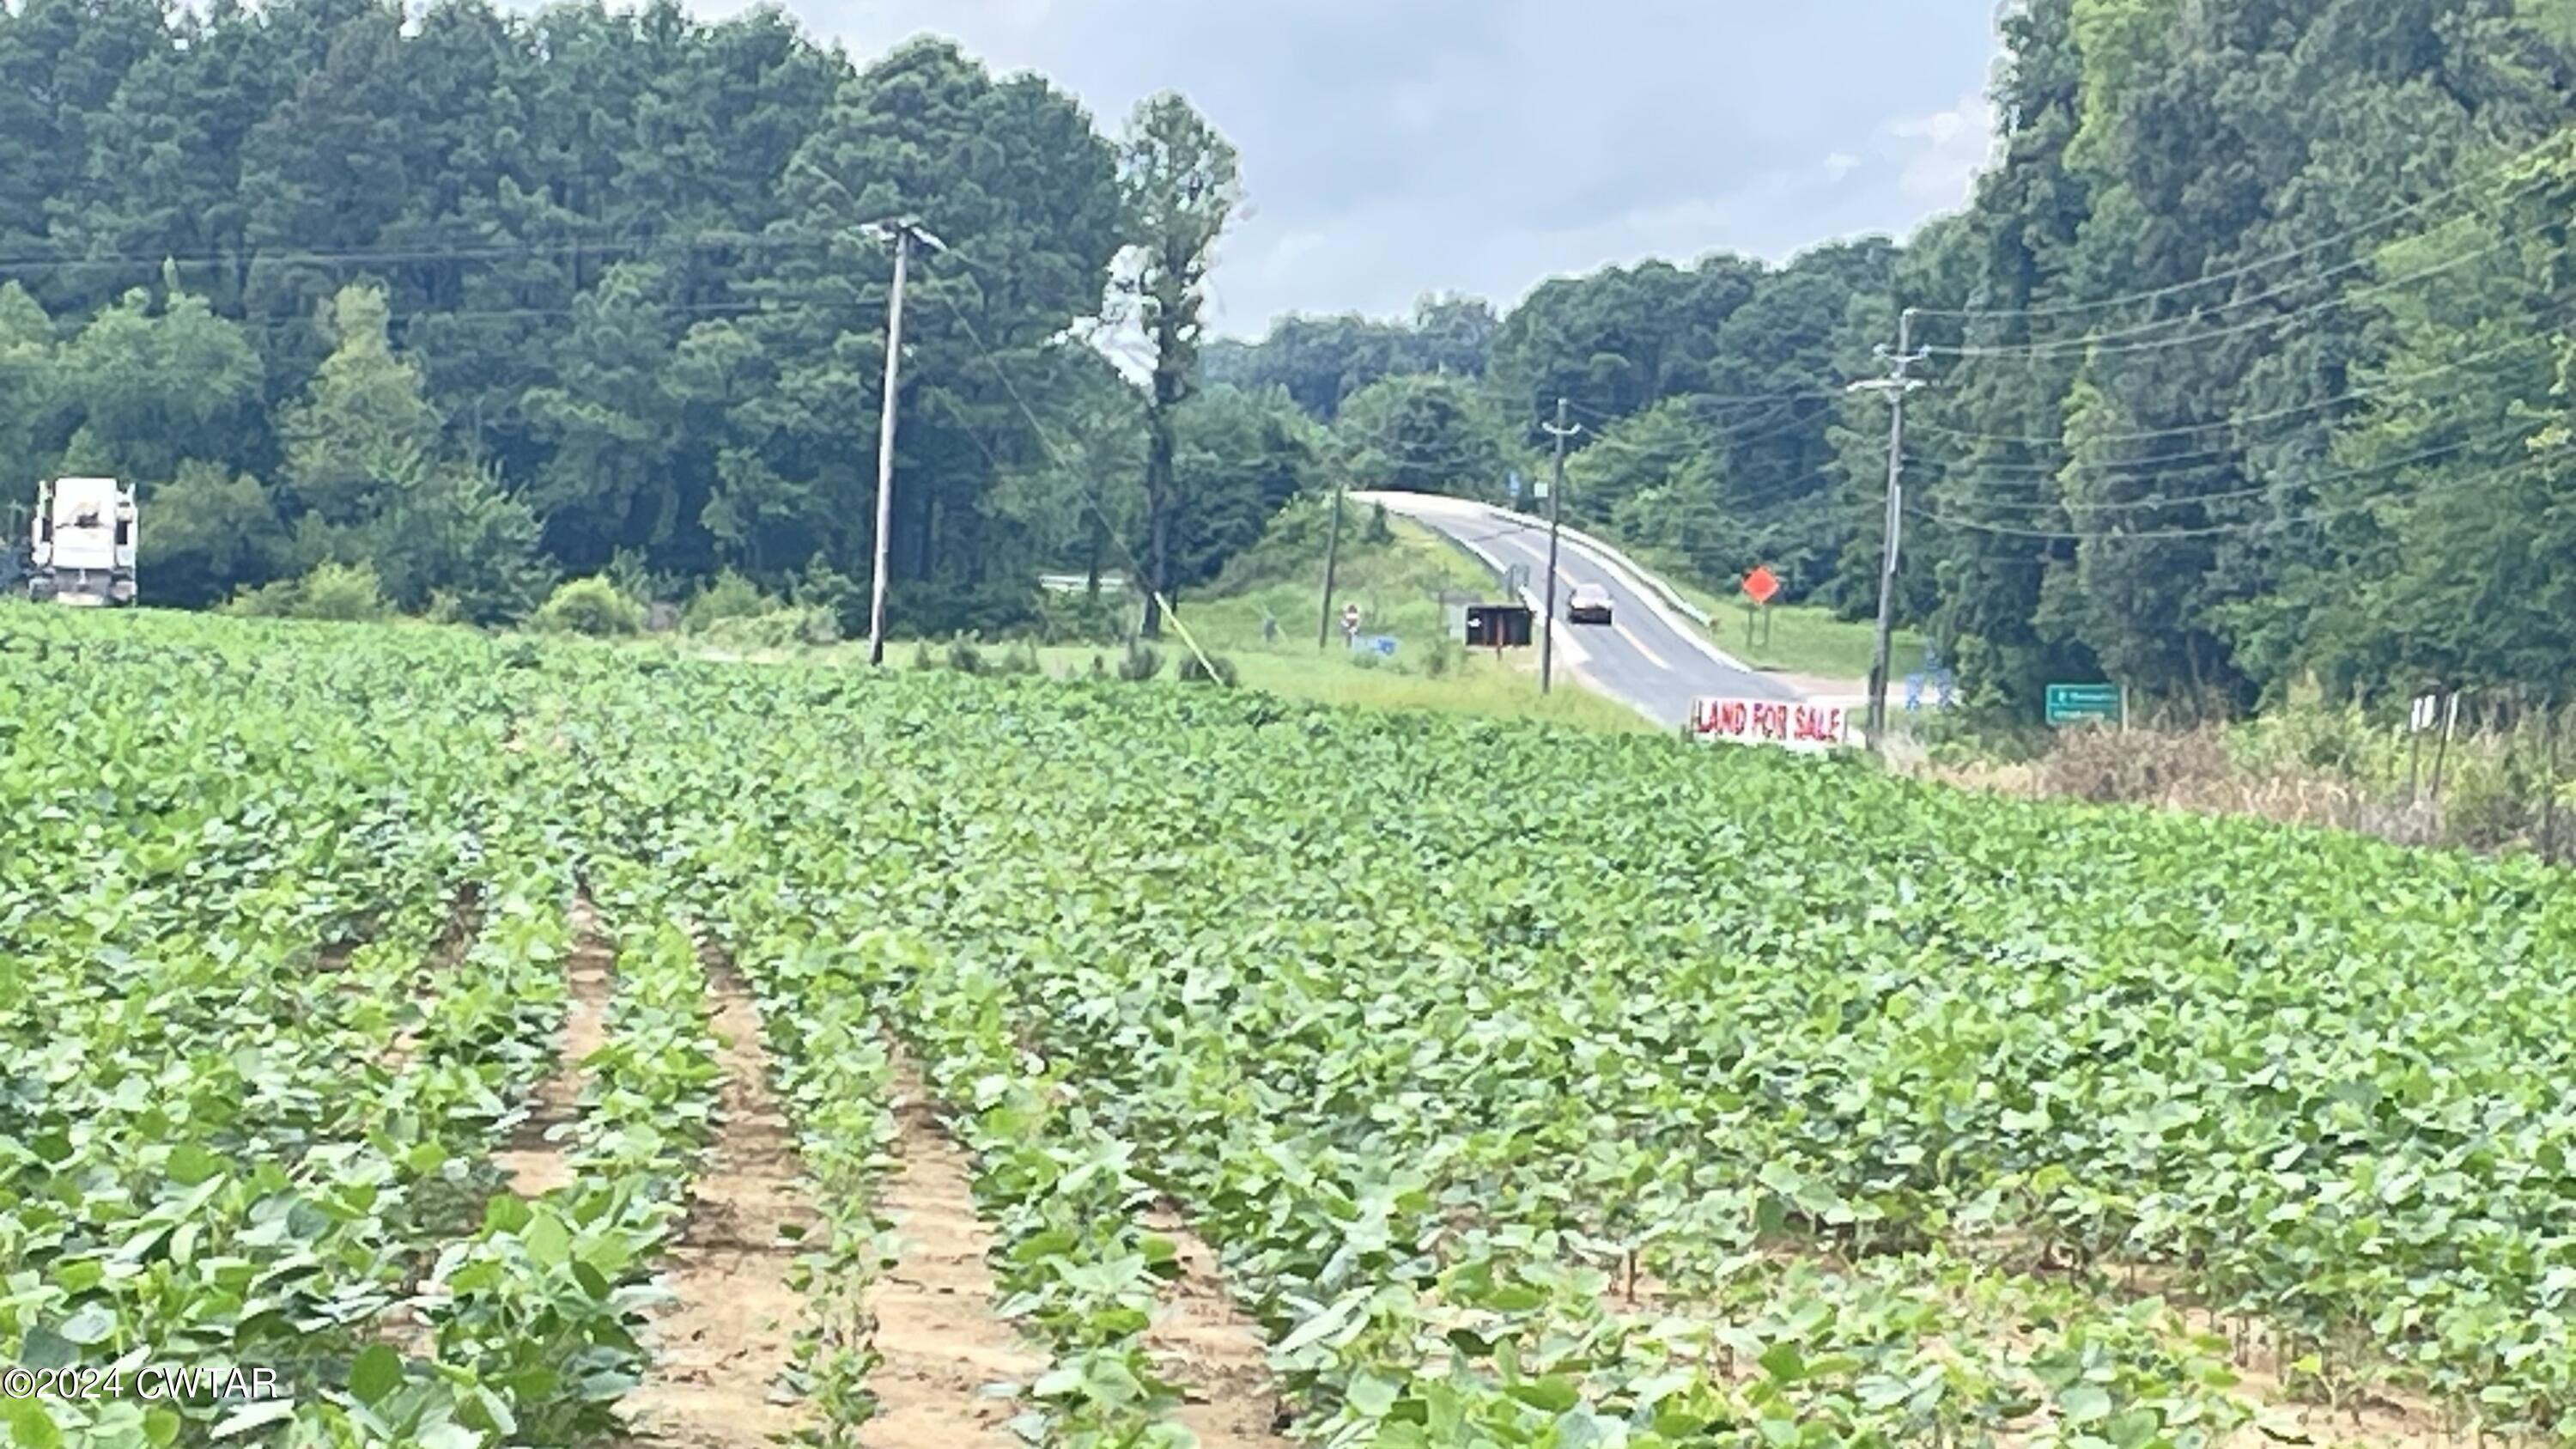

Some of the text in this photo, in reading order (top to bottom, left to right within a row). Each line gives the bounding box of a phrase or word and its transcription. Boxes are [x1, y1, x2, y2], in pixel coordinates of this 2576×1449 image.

[1698, 700, 1840, 742] LAND FOR SALE
